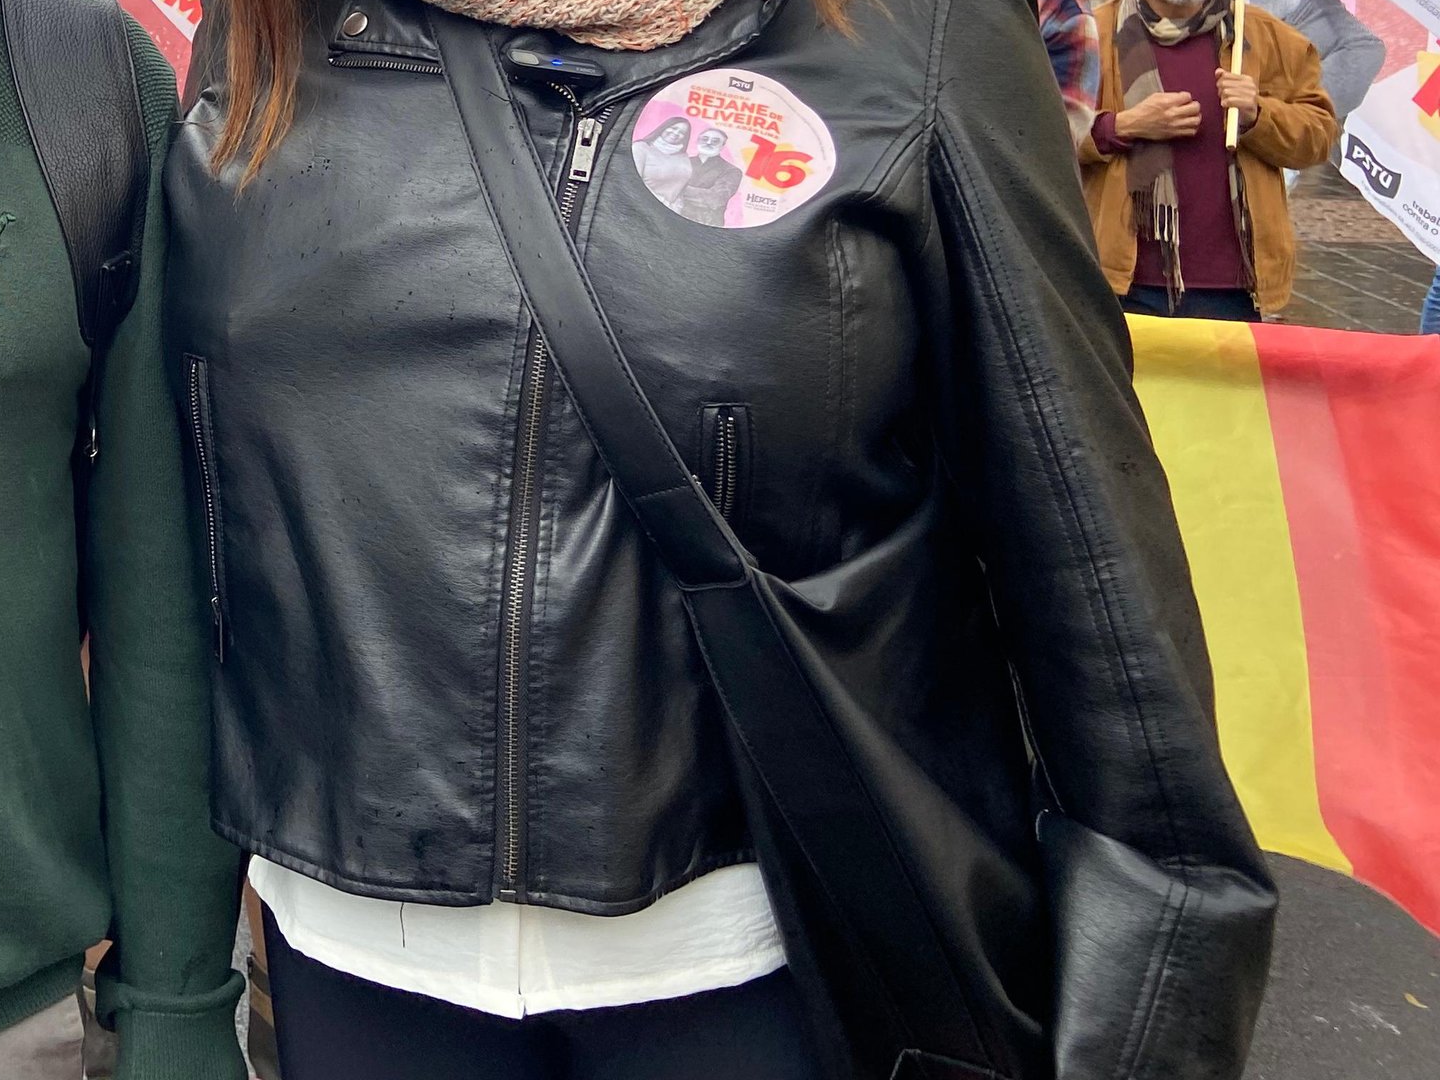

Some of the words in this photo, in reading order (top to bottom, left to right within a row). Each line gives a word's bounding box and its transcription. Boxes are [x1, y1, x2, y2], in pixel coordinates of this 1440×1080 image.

[731, 80, 750, 89] PSTU
[686, 105, 780, 134] OLIVEIRA
[687, 91, 769, 117] REJANE
[768, 111, 784, 122] DE
[745, 134, 814, 189] 16
[1352, 144, 1393, 189] PSTU
[1402, 203, 1431, 231] contra
